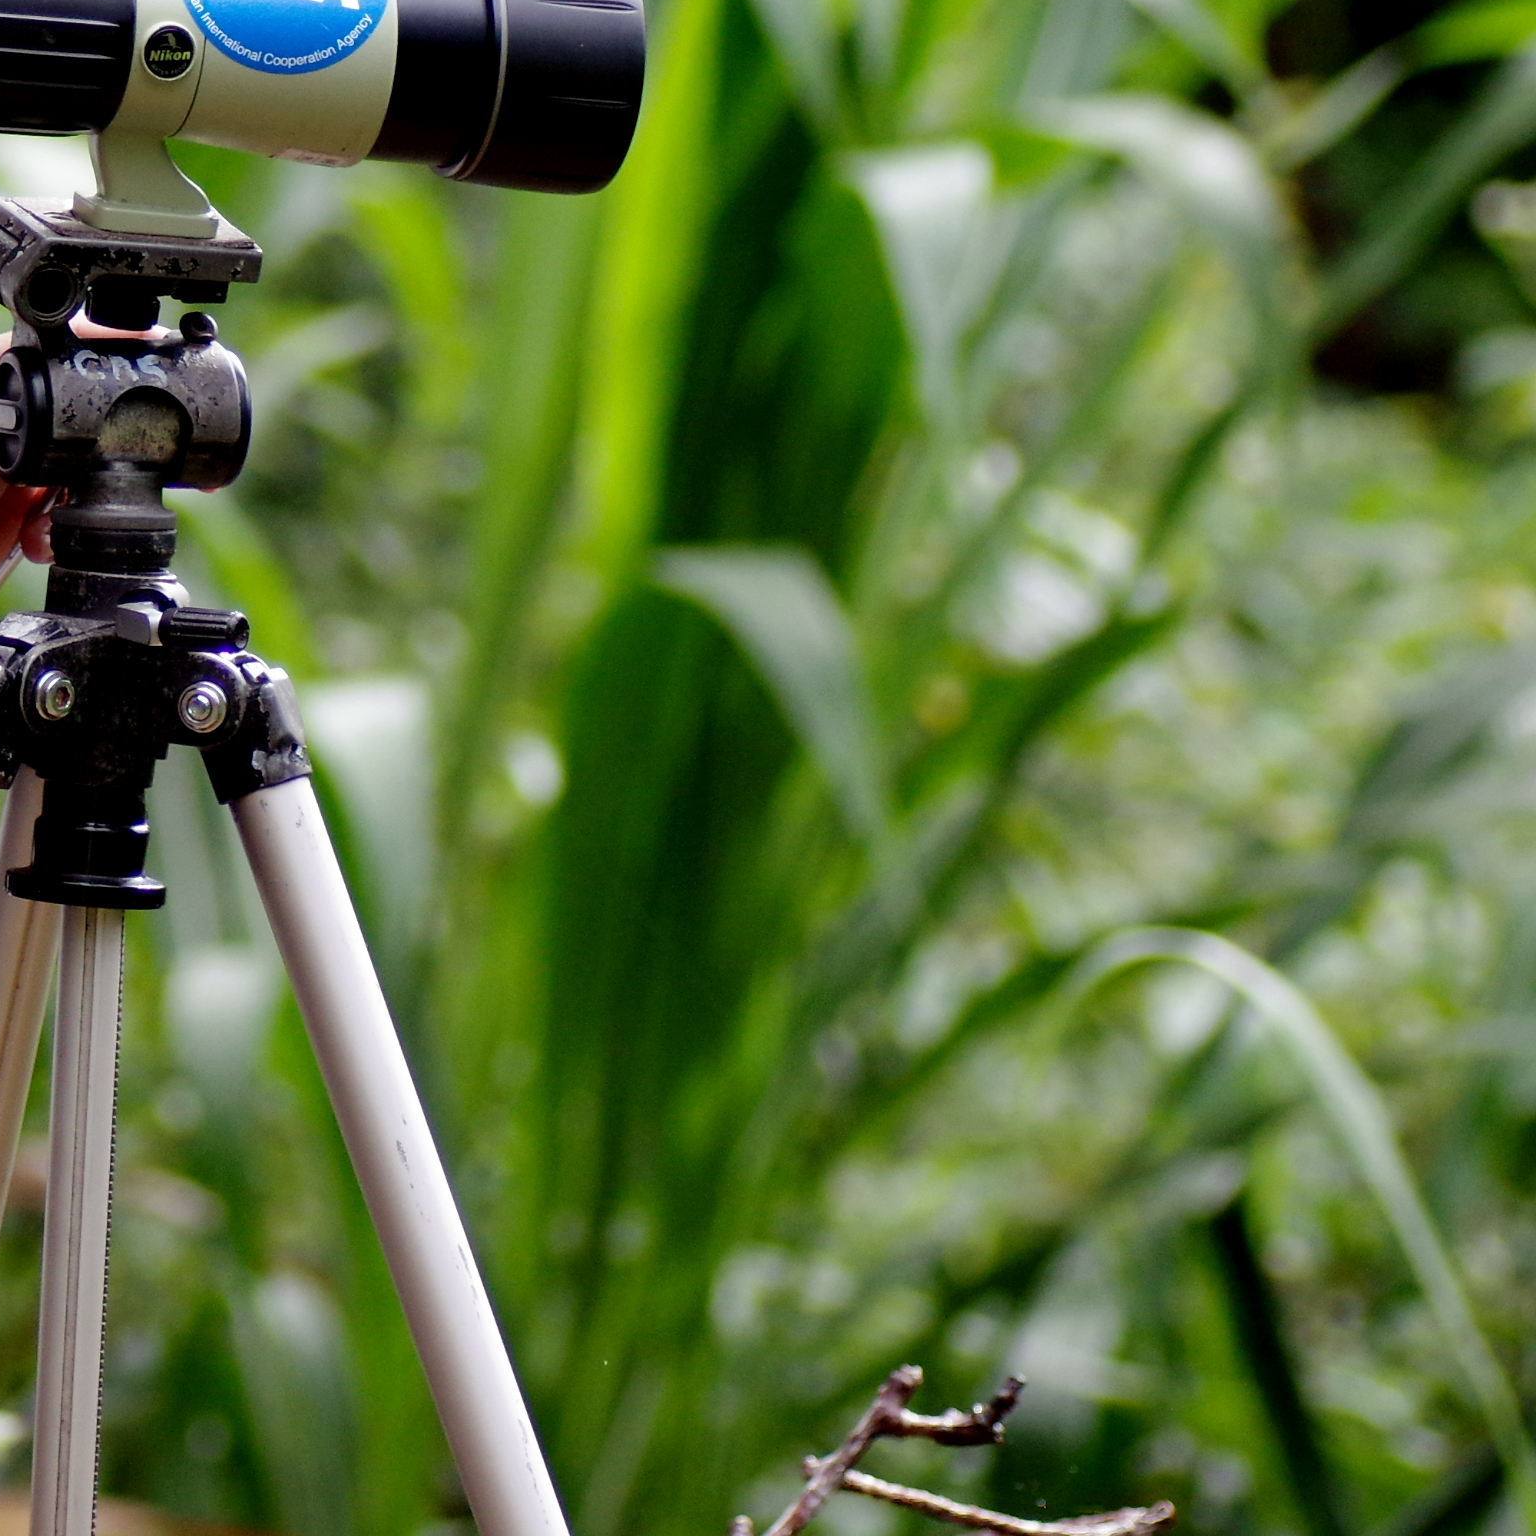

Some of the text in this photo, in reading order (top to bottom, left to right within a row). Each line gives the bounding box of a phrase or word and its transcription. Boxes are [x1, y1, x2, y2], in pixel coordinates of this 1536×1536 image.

[149, 49, 191, 61] Nikon
[200, 12, 262, 62] International
[263, 46, 337, 68] Cooperation
[337, 13, 373, 50] Agency
